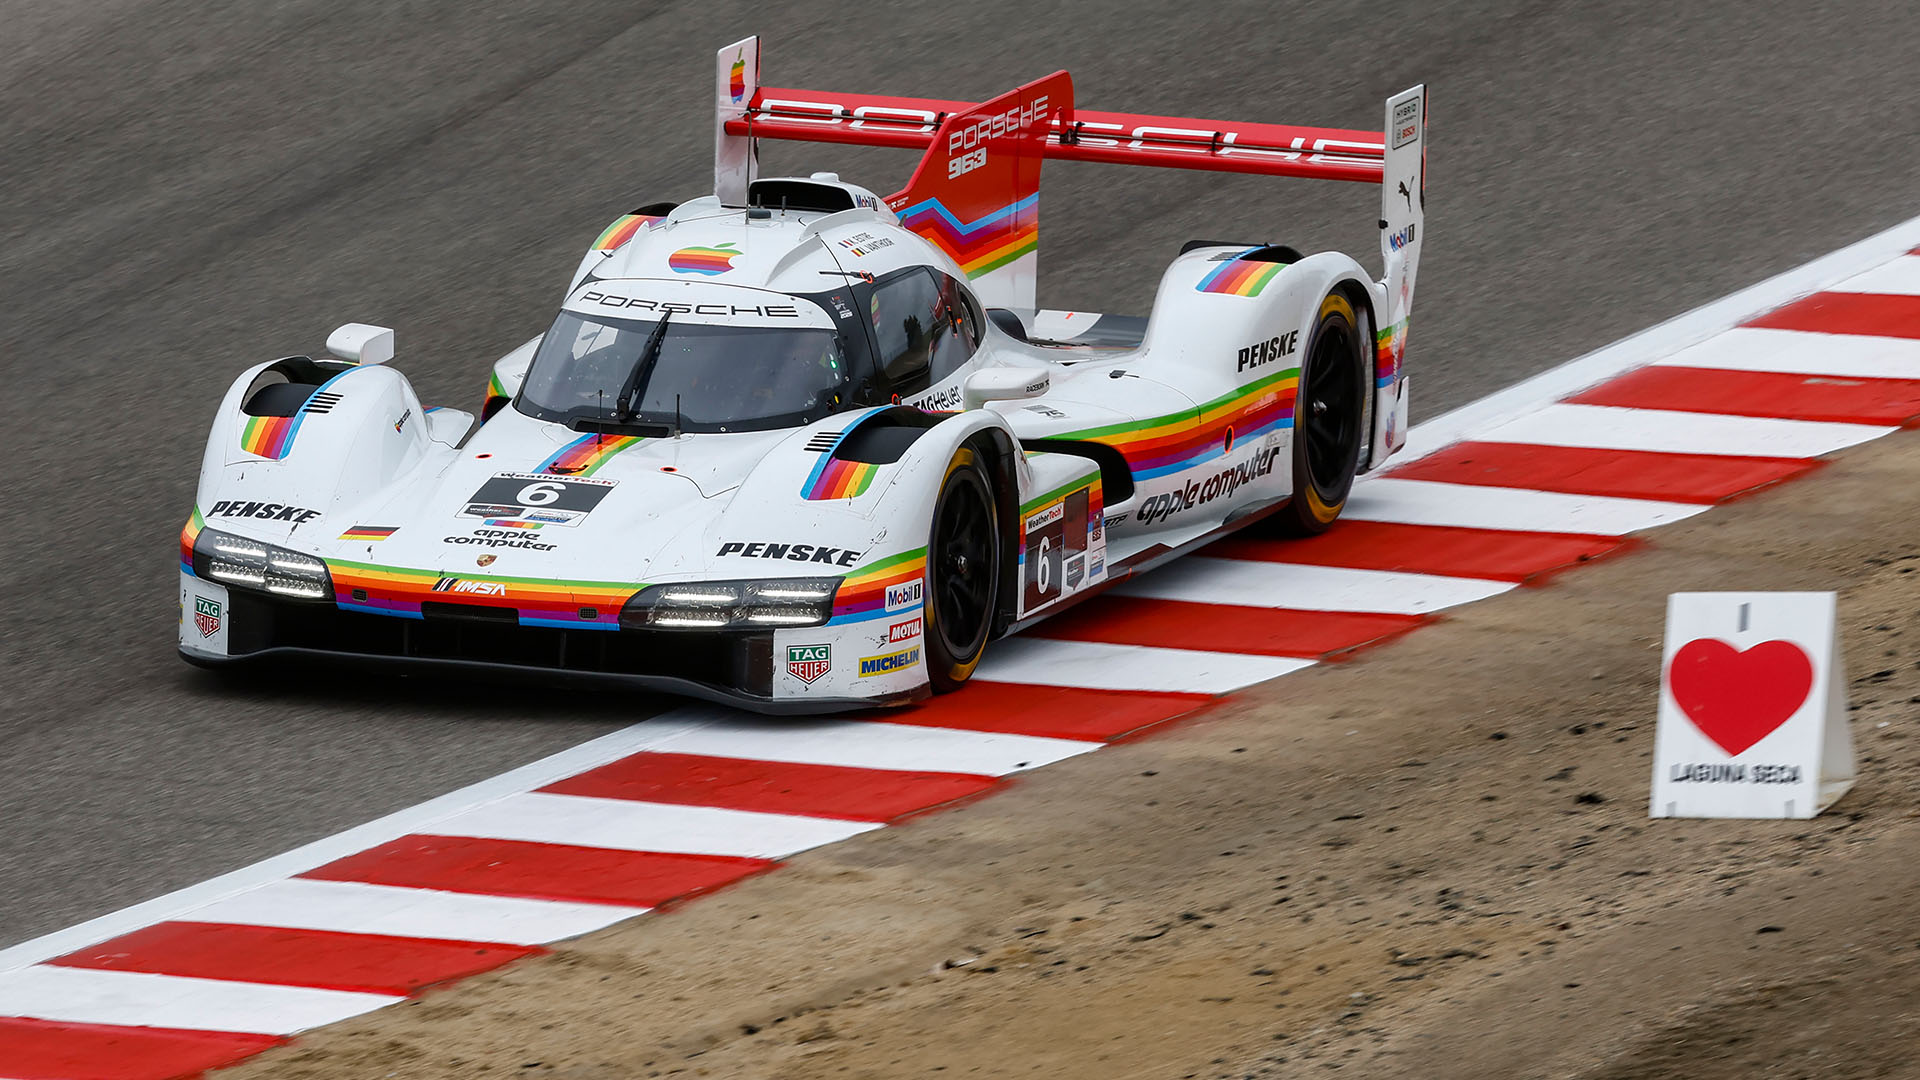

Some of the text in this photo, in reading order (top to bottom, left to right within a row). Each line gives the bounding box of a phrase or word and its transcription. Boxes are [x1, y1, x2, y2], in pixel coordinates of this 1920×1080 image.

[754, 98, 1384, 166] POSCHE
[948, 95, 1049, 156] PORSCHE
[1402, 125, 1416, 139] BOSCH
[948, 147, 987, 180] 963
[855, 194, 872, 208] Mobil
[1390, 226, 1408, 252] Mobil
[579, 291, 799, 318] PORSCHE
[1237, 330, 1299, 373] PENSKE
[500, 472, 615, 486] WeatherTech
[1136, 447, 1280, 525] apple computer
[516, 482, 567, 506] 6
[205, 500, 322, 524] PENSKE
[1027, 507, 1062, 530] WeatherTech
[443, 536, 558, 551] computer
[473, 529, 541, 541] apple
[716, 542, 862, 568] PENSKE
[1038, 536, 1050, 594] 6
[454, 582, 506, 596] IMSA
[888, 583, 921, 607] Mobil 1
[197, 599, 219, 617] TAG
[1738, 602, 1750, 633] I
[195, 613, 219, 634] HEUER
[891, 620, 921, 641] MOTUL
[791, 647, 827, 661] TAG
[861, 649, 920, 674] MICHELIN
[790, 661, 828, 683] HEUER
[1670, 763, 1802, 784] LAGUNA SECA
